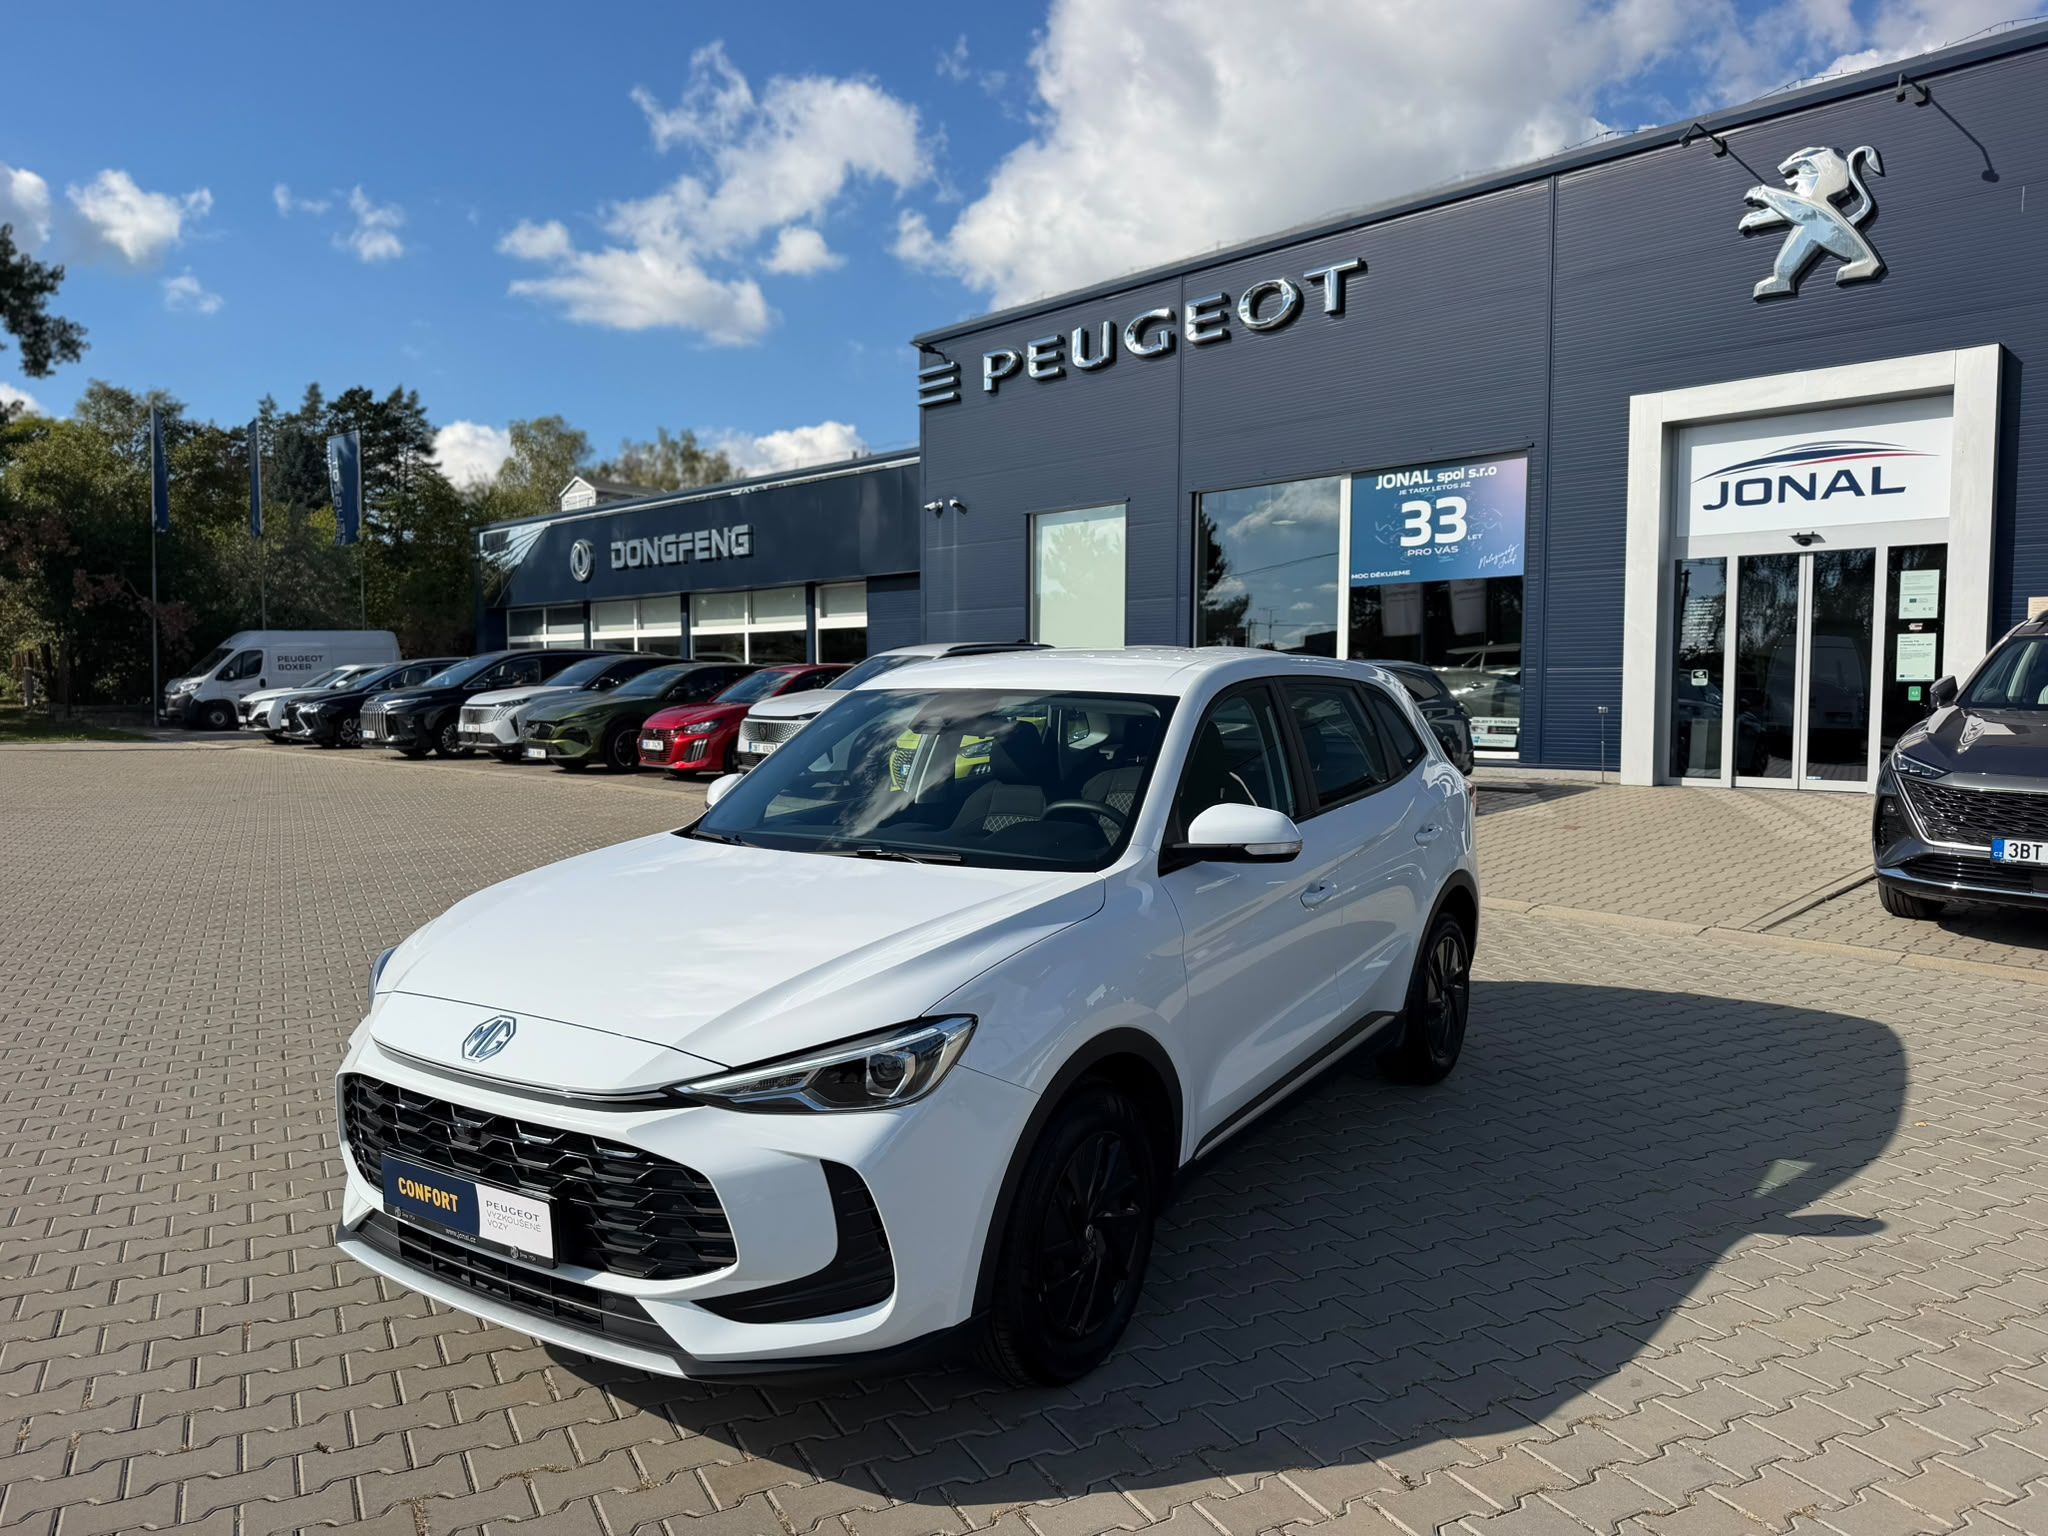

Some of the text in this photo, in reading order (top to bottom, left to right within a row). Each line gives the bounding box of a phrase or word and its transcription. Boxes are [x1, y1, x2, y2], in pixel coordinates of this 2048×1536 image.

[983, 257, 1364, 392] PEUGEOT
[1376, 466, 1497, 490] JONAL spol s.r.o
[1432, 483, 1459, 492] LETOS
[1703, 466, 1906, 510] JONAL
[1400, 496, 1468, 547] 33
[611, 524, 750, 569] DONGFENG
[1407, 545, 1459, 556] PRO VÁS
[1370, 569, 1411, 578] DĚKUJEME
[277, 655, 324, 663] PEUGEOT
[278, 663, 312, 671] BOXER
[2008, 843, 2043, 860] 3BT
[466, 1019, 511, 1058] MG
[397, 1177, 459, 1213] CONFORT
[486, 1200, 540, 1222] PEUGEOT
[486, 1210, 541, 1233] VYZKOUŠENÉ
[487, 1219, 509, 1232] VOZY
